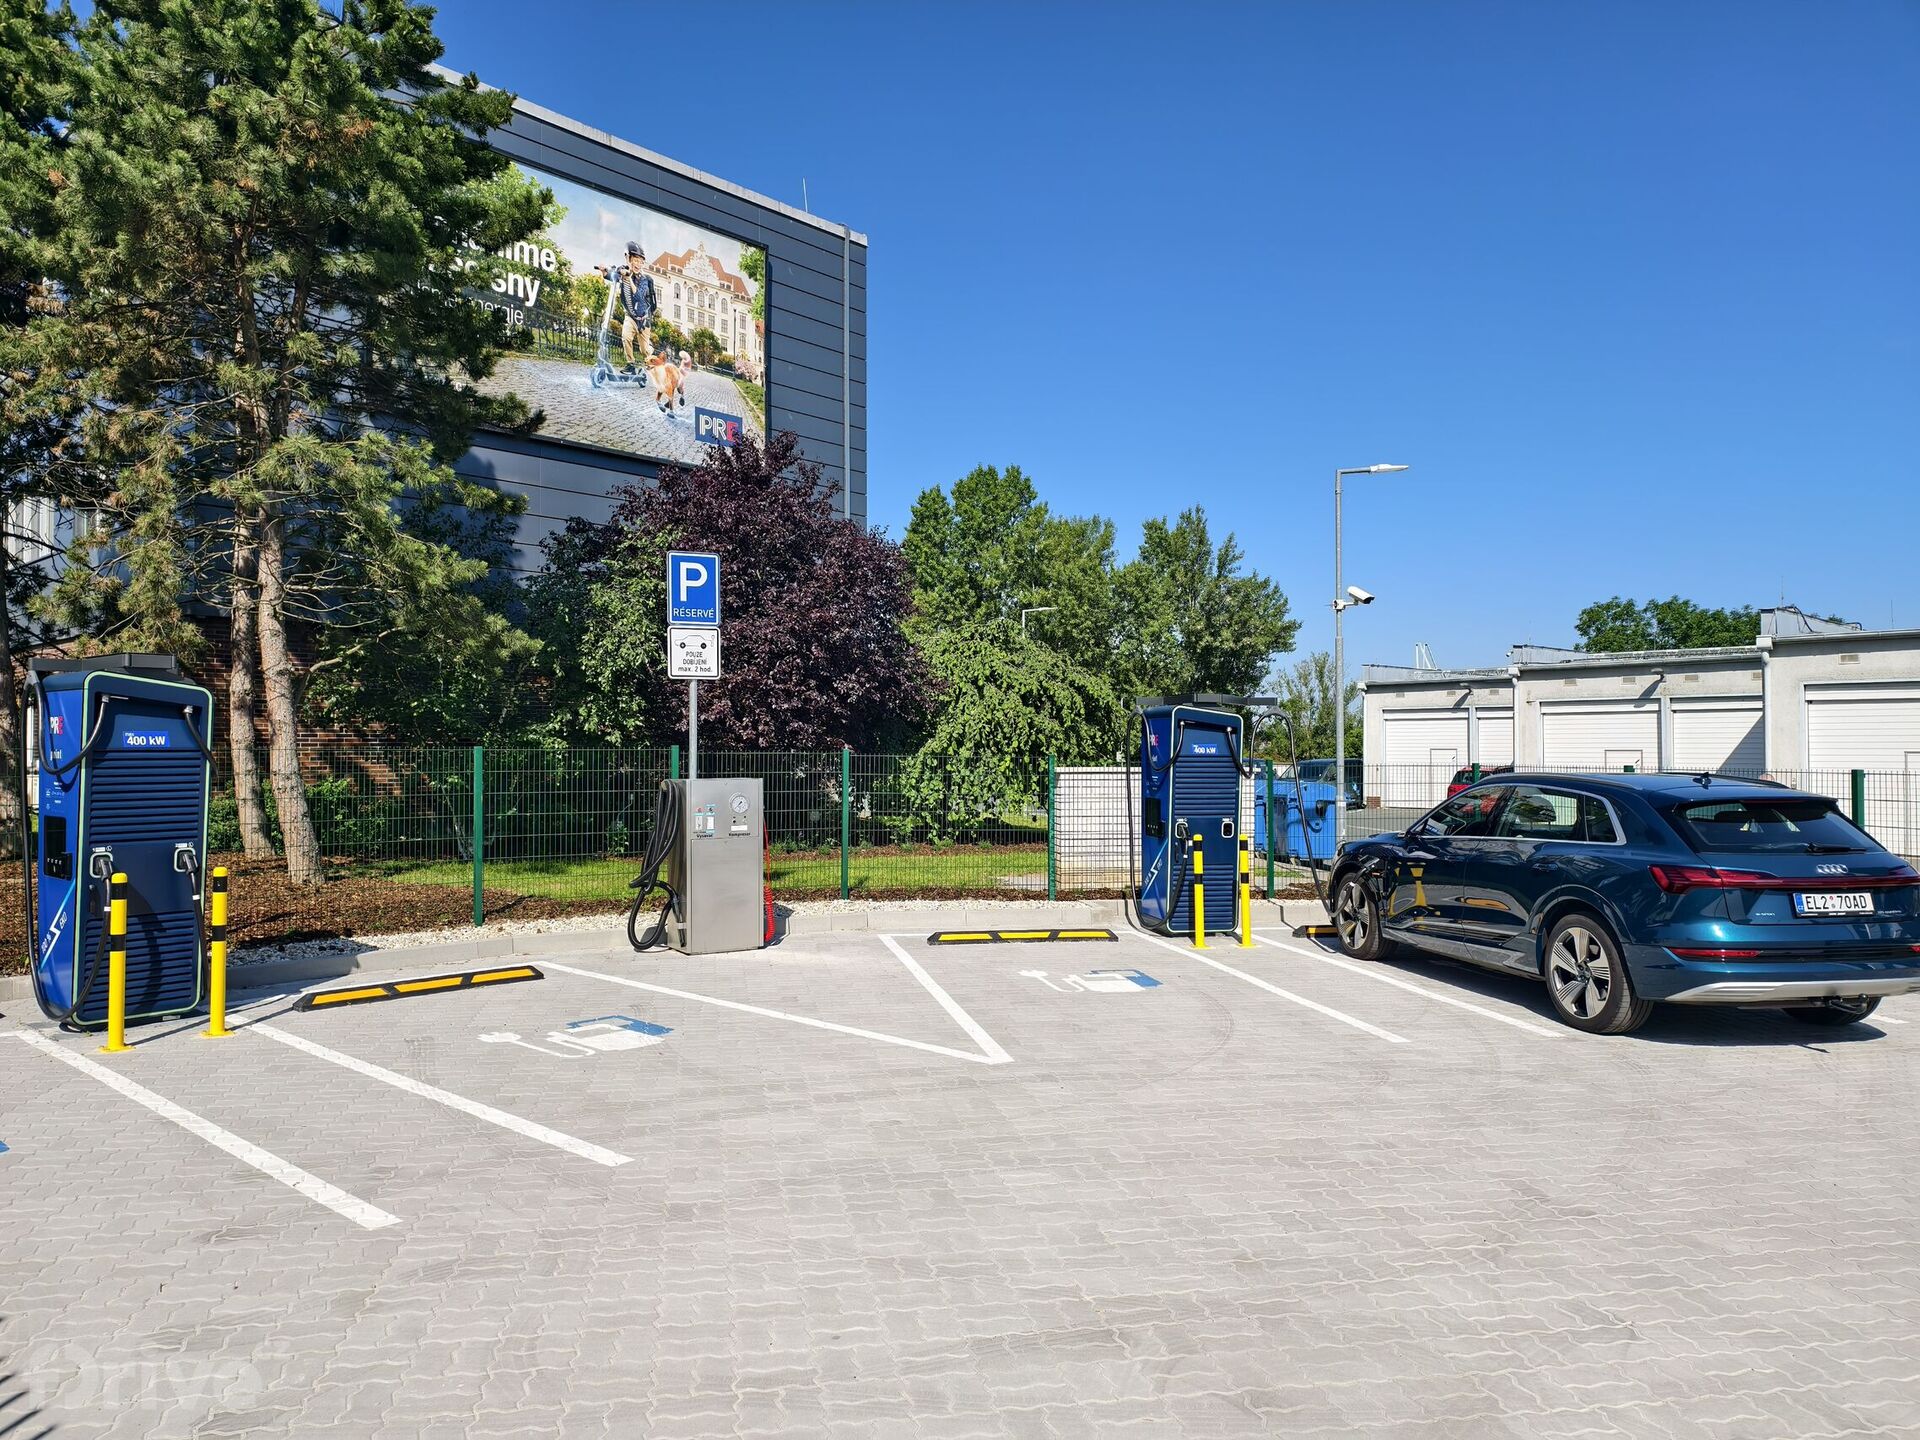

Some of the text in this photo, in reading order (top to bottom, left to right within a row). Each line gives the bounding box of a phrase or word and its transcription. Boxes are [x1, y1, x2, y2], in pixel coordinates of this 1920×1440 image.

[679, 561, 708, 602] P
[673, 607, 715, 618] RÉSERVÉ
[685, 650, 703, 658] POUZE
[126, 735, 166, 746] 400 kW
